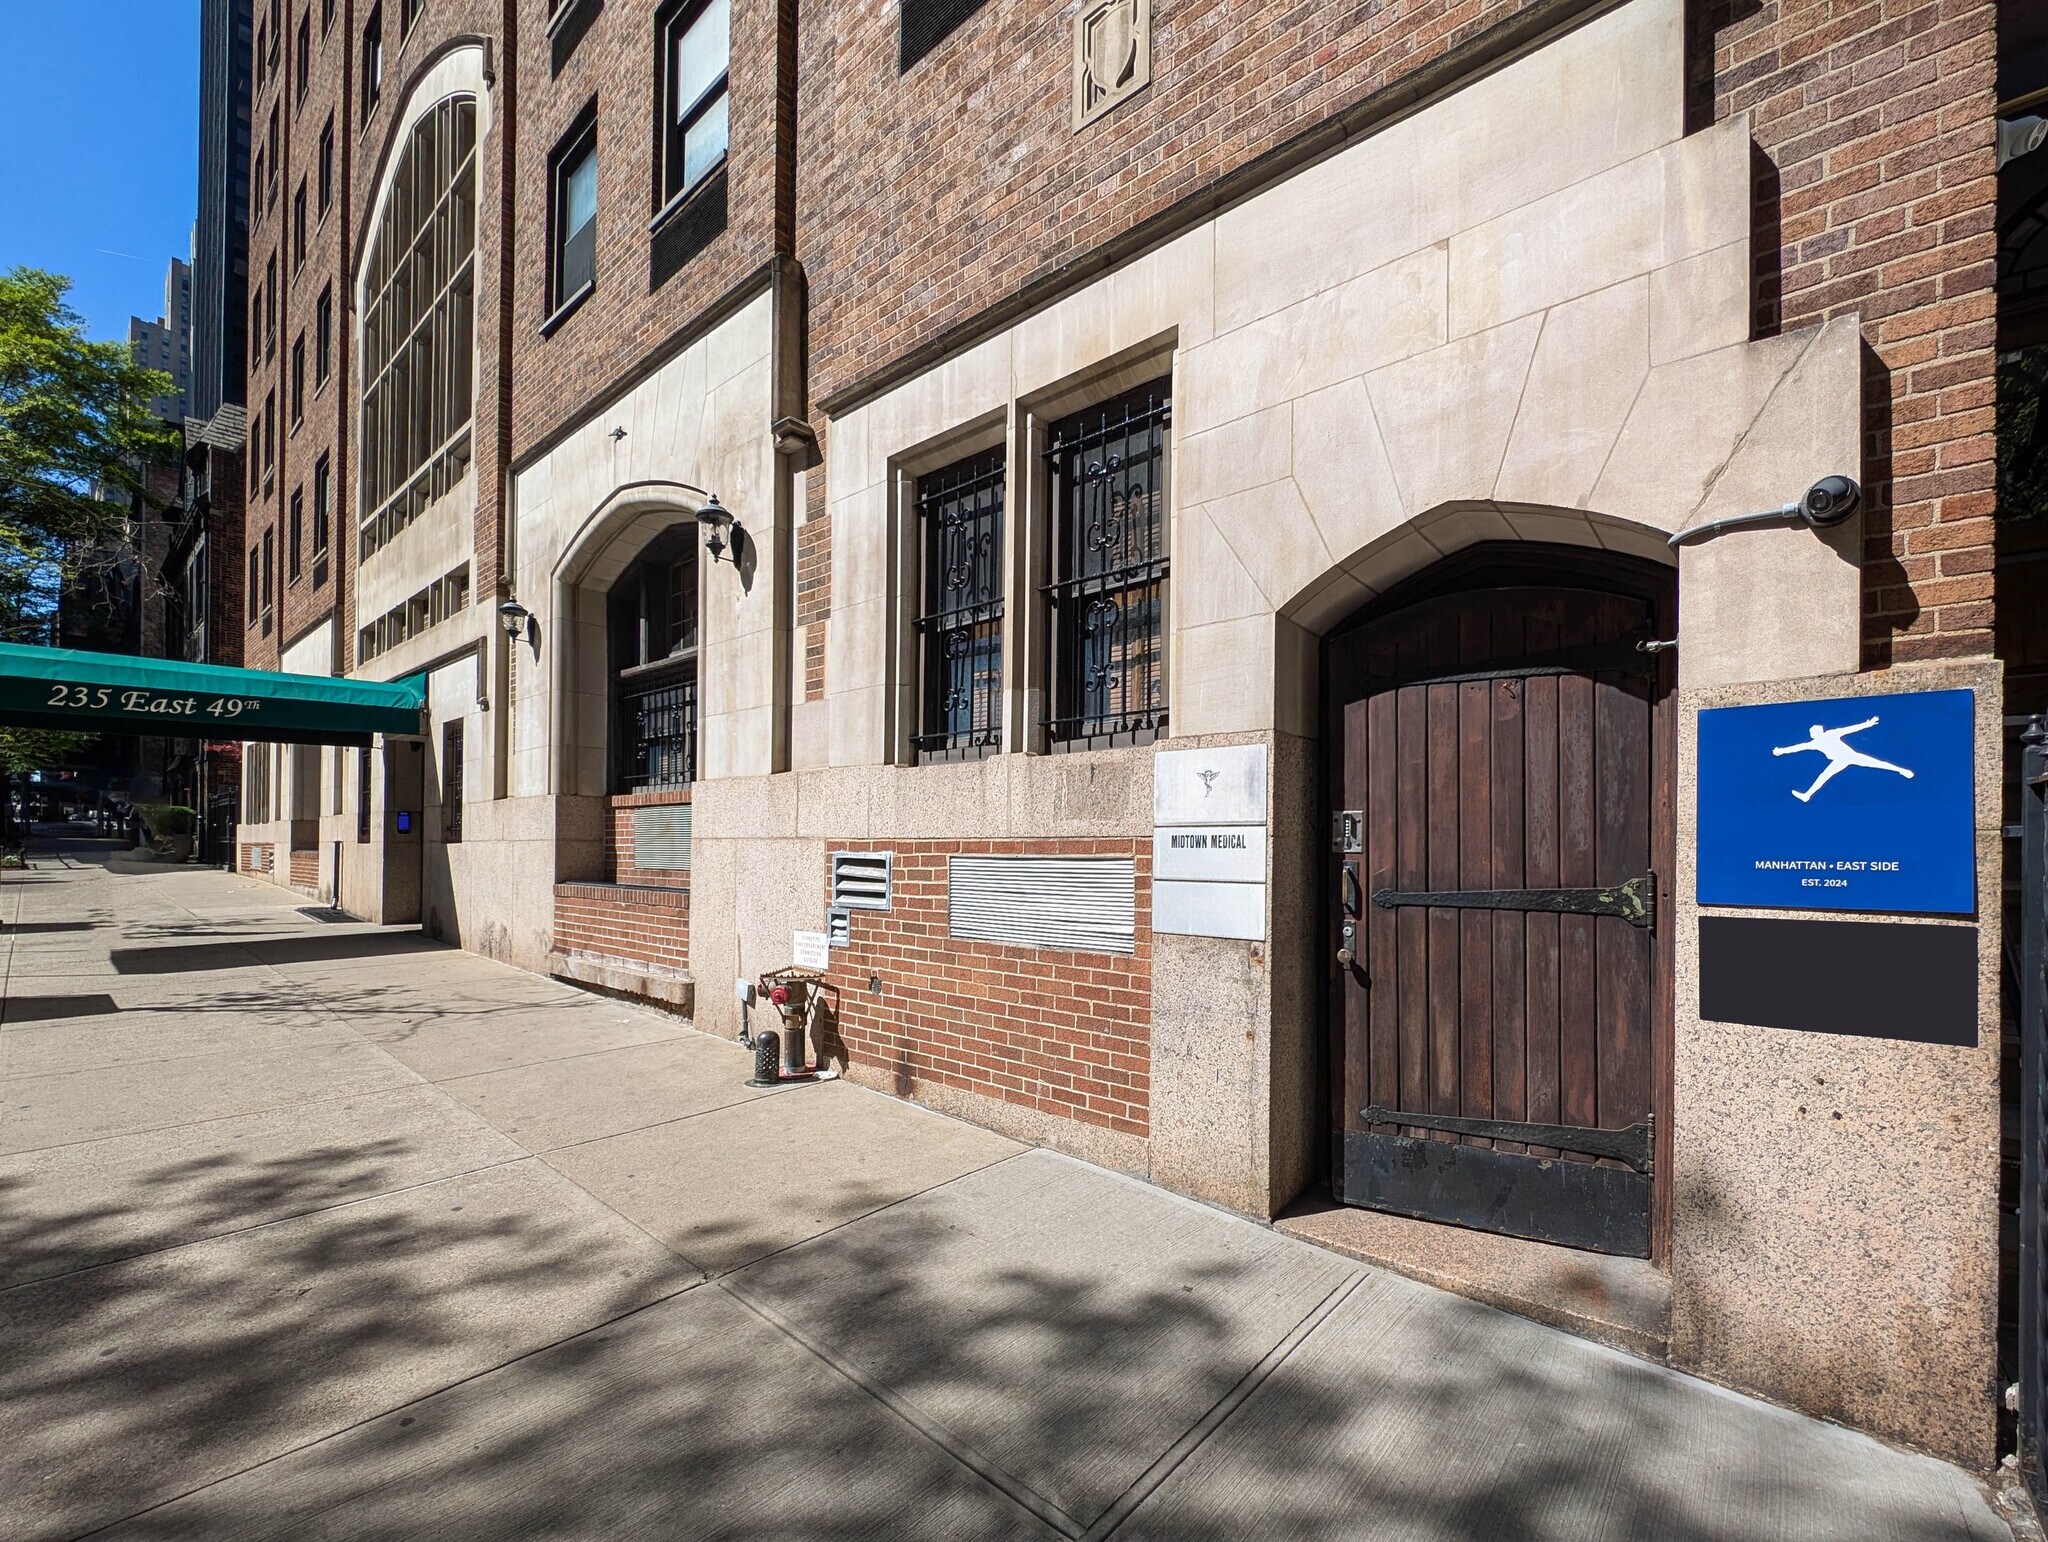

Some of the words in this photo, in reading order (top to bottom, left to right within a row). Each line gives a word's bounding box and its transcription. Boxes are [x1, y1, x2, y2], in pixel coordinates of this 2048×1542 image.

[47, 685, 112, 709] 235
[120, 691, 197, 715] East
[1171, 834, 1208, 849] MIDTOWN
[1210, 834, 1246, 849] MEDICAL
[1755, 860, 1826, 870] MANHATTAN
[1836, 861, 1867, 871] EAST
[1870, 861, 1900, 872] SIDE
[1801, 878, 1821, 887] EST.
[1823, 879, 1848, 887] 2024
